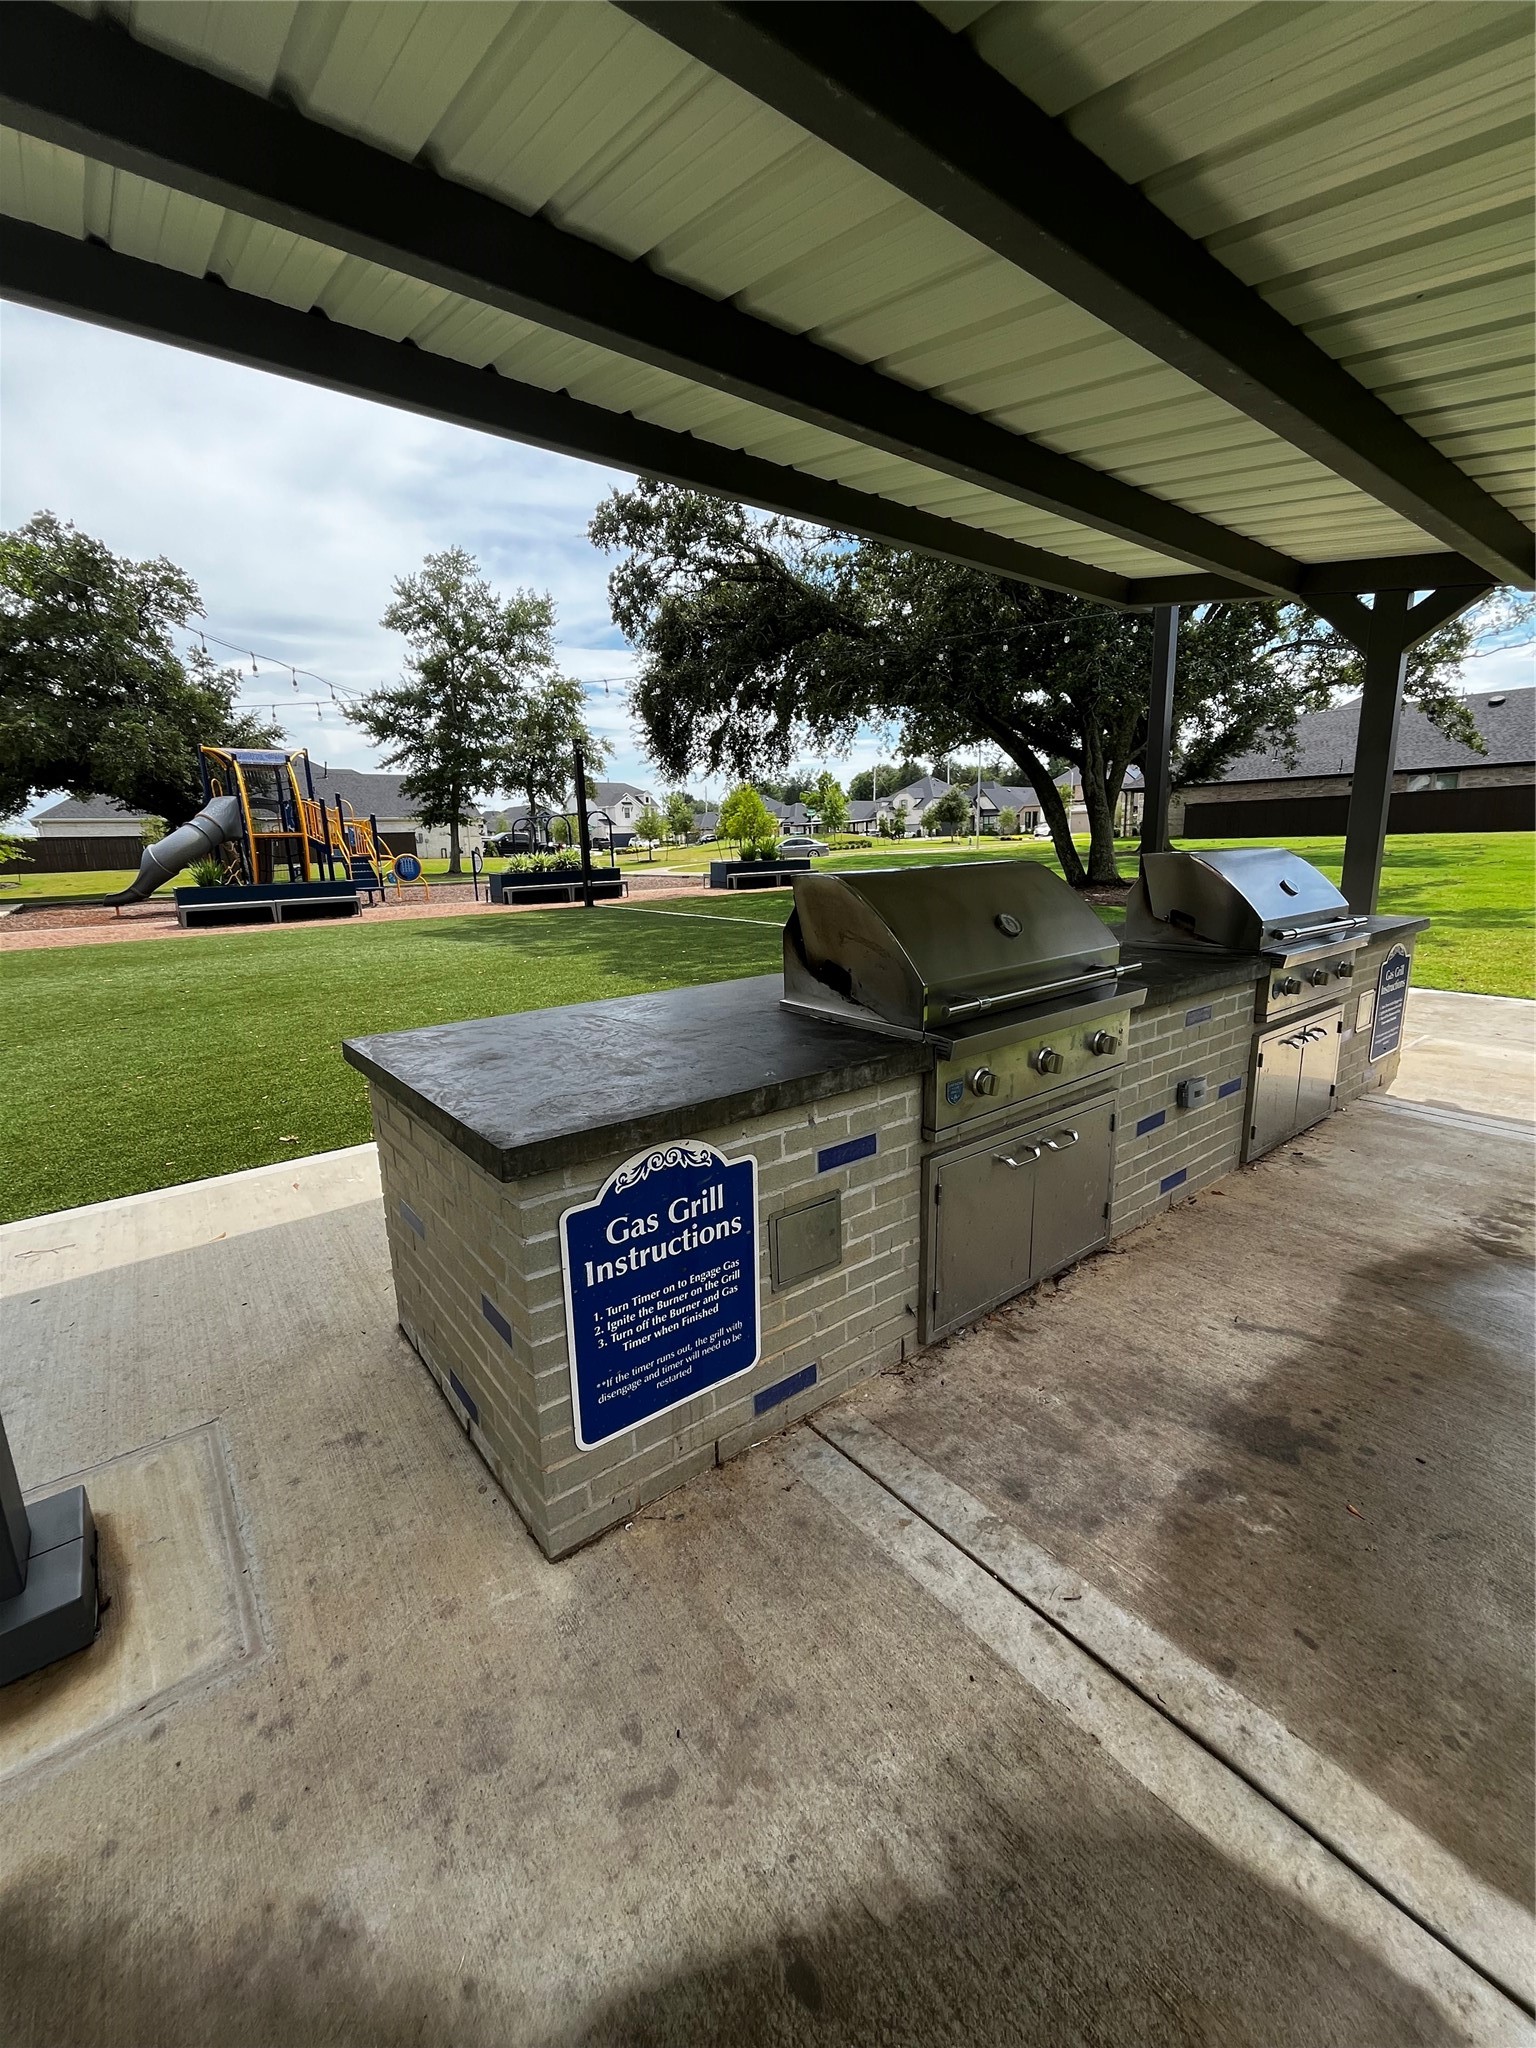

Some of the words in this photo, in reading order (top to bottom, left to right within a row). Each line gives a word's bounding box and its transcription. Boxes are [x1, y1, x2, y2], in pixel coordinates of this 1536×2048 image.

[606, 1213, 659, 1245] Gas
[668, 1184, 724, 1223] Grill
[585, 1216, 742, 1287] Instructions
[593, 1312, 603, 1322] 1.
[606, 1302, 629, 1317] Turn
[632, 1290, 661, 1307] Timer
[663, 1284, 675, 1294] on
[678, 1279, 687, 1289] to
[690, 1266, 721, 1284] Engage
[723, 1259, 740, 1271] Gas
[594, 1326, 604, 1336] 2.
[607, 1314, 636, 1333] Ignite
[638, 1305, 654, 1318] the
[657, 1292, 688, 1311] Burner
[691, 1286, 702, 1297] on
[705, 1279, 719, 1291] the
[721, 1269, 740, 1284] Grill
[597, 1339, 608, 1349] 3.
[611, 1328, 633, 1343] Turn
[636, 1320, 650, 1333] off
[652, 1314, 667, 1326] the
[670, 1300, 700, 1318] Burner
[703, 1292, 720, 1305] and
[722, 1284, 738, 1297] Gas
[615, 1371, 630, 1384] the
[632, 1359, 654, 1376] timer
[656, 1351, 675, 1364] runs
[677, 1342, 693, 1356] out,
[695, 1335, 708, 1347] the
[710, 1327, 724, 1343] grill
[726, 1321, 743, 1333] with
[622, 1334, 651, 1352] Timer
[654, 1322, 679, 1338] when
[682, 1303, 719, 1326] Finished
[598, 1379, 642, 1404] disengage
[644, 1369, 660, 1383] and
[662, 1358, 684, 1374] timer
[686, 1350, 700, 1363] will
[702, 1341, 721, 1356] need
[722, 1338, 731, 1347] to
[732, 1332, 742, 1342] be
[656, 1365, 692, 1389] restarted
